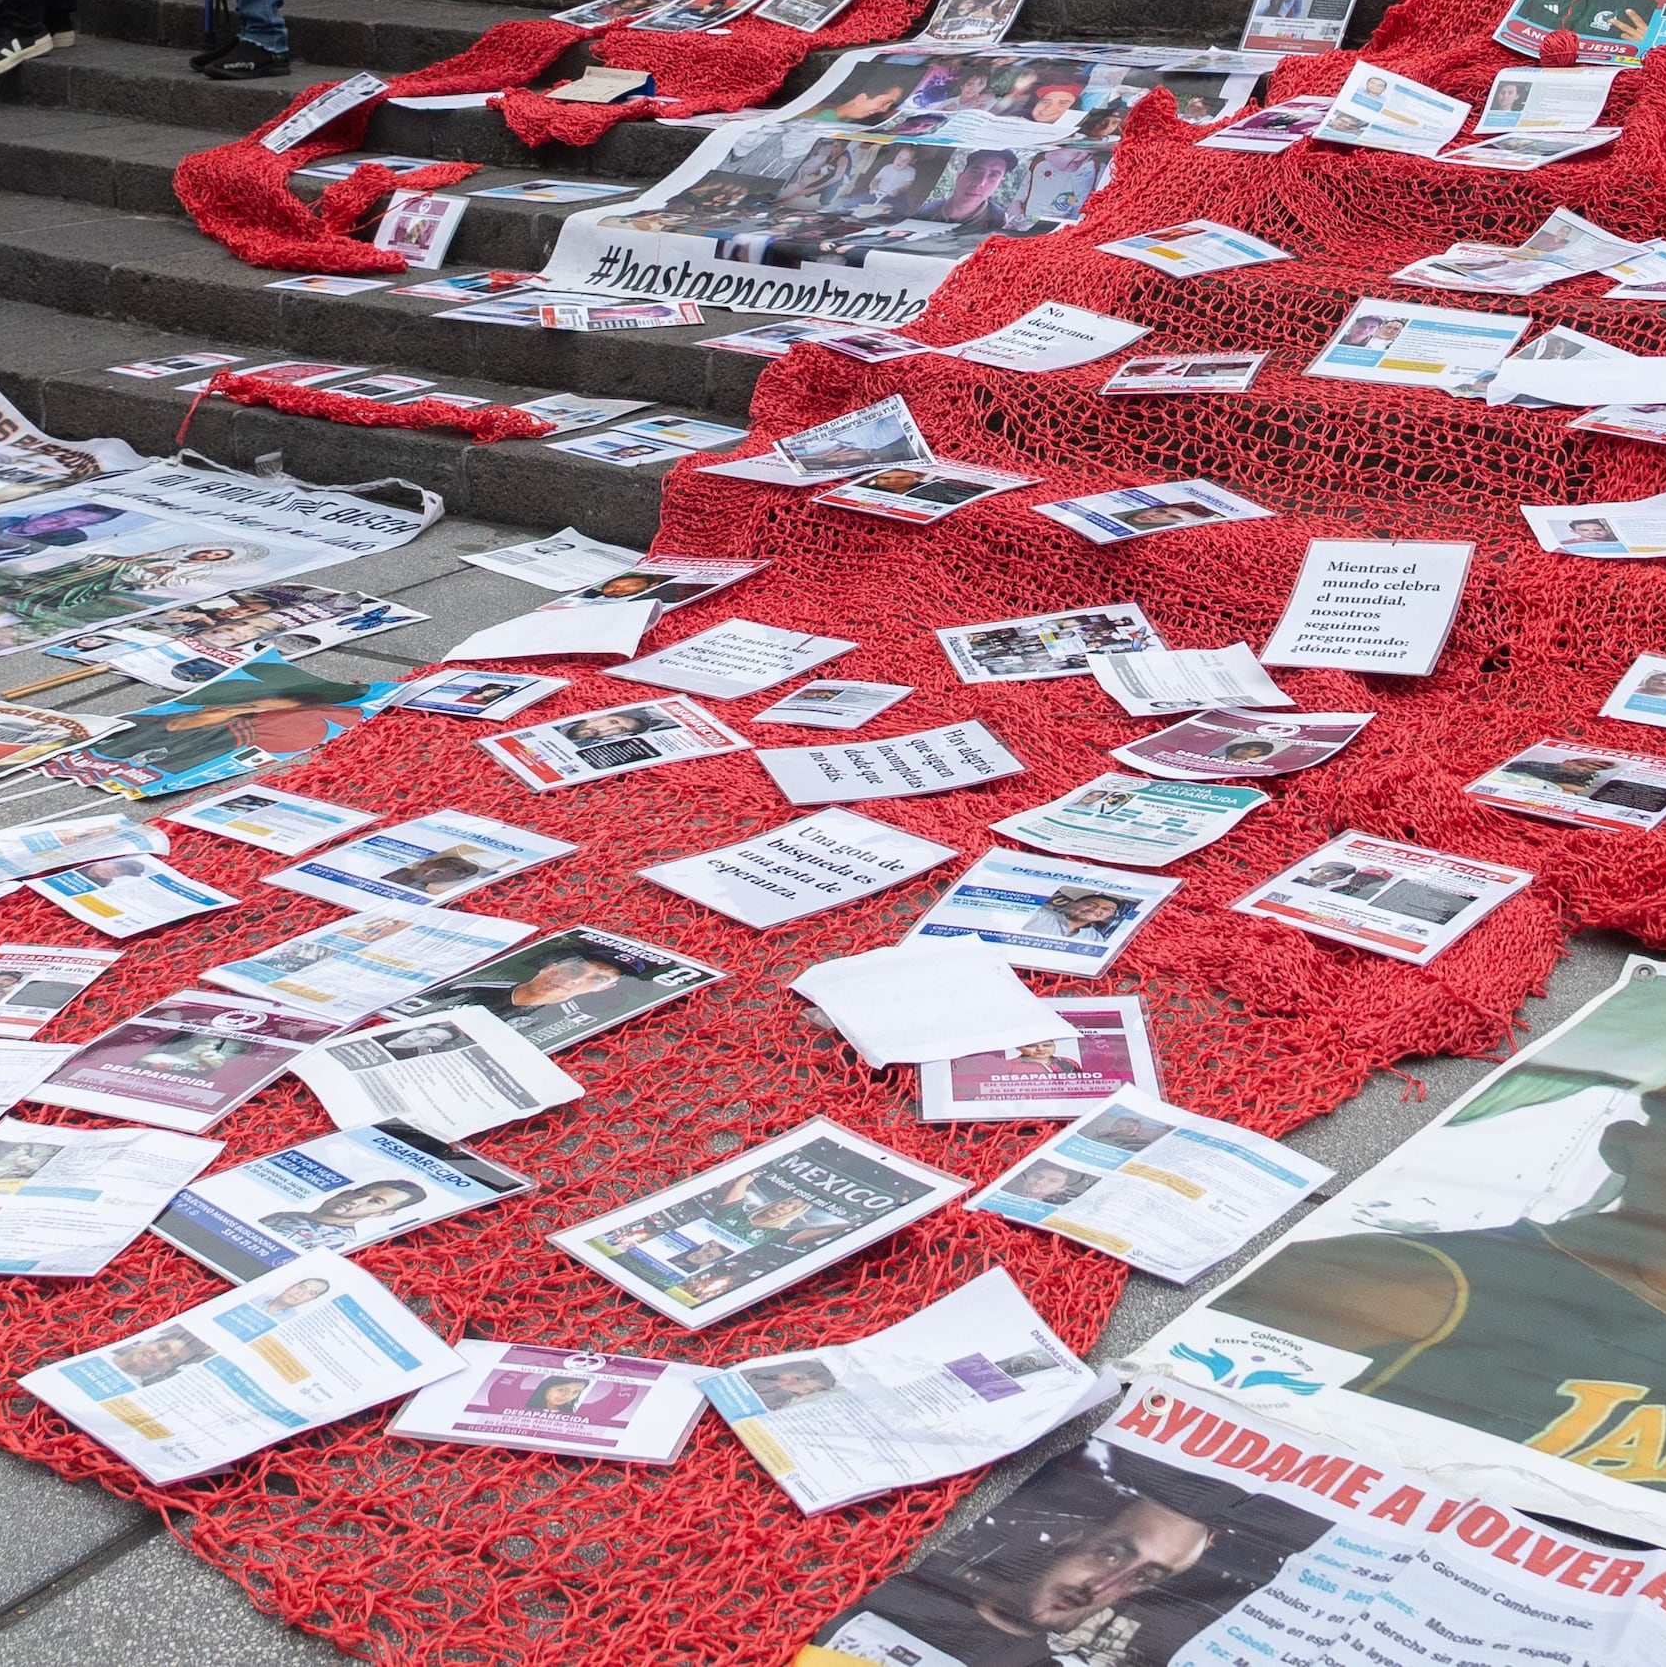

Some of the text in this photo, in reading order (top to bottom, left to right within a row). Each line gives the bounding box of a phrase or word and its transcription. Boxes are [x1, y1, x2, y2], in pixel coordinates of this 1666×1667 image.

[584, 244, 930, 325] #hastaencontrarte
[1042, 306, 1066, 319] No
[1012, 327, 1053, 342] que el
[1027, 317, 1097, 343] dejaremos
[995, 335, 1048, 352] silencio
[1326, 560, 1417, 575] Mientras el
[1322, 578, 1441, 593] mundo celebra
[1316, 592, 1407, 608] el mundial,
[1303, 619, 1381, 633] seguimos
[1310, 607, 1382, 620] nosotros
[1289, 643, 1408, 660] ¿dónde están?
[1296, 633, 1411, 648] preguntando:
[907, 739, 955, 778] que siguen
[942, 729, 996, 776] Hay alegrías
[809, 751, 845, 784] no estás.
[842, 747, 884, 785] desde que
[876, 744, 927, 789] incompletas
[765, 837, 877, 886] búsqueda es
[796, 826, 907, 873] Una gota de
[736, 848, 842, 895] una gota de
[1361, 844, 1502, 882] DESAPARECIDO
[706, 856, 797, 901] esperanza.
[1012, 866, 1132, 891] DESAPARECIDO
[2, 953, 103, 966] DESAPARECIDO
[579, 932, 672, 966] DESAPARECIDO
[100, 1063, 215, 1089] DESAPARECIDA
[990, 1072, 1103, 1082] DESAPARECIDO
[371, 1135, 471, 1190] DESAPARECIDO
[779, 1153, 894, 1211] MEXICO
[1214, 1337, 1281, 1353] Entre Cielo
[1250, 1330, 1303, 1352] Colectivo
[502, 1408, 591, 1425] DESAPARECIDA
[1115, 1391, 1385, 1511] AYUDAME
[1373, 1482, 1432, 1527] A
[1425, 1497, 1654, 1597] VOLVER
[1431, 1561, 1561, 1624] Giovanni Camberos
